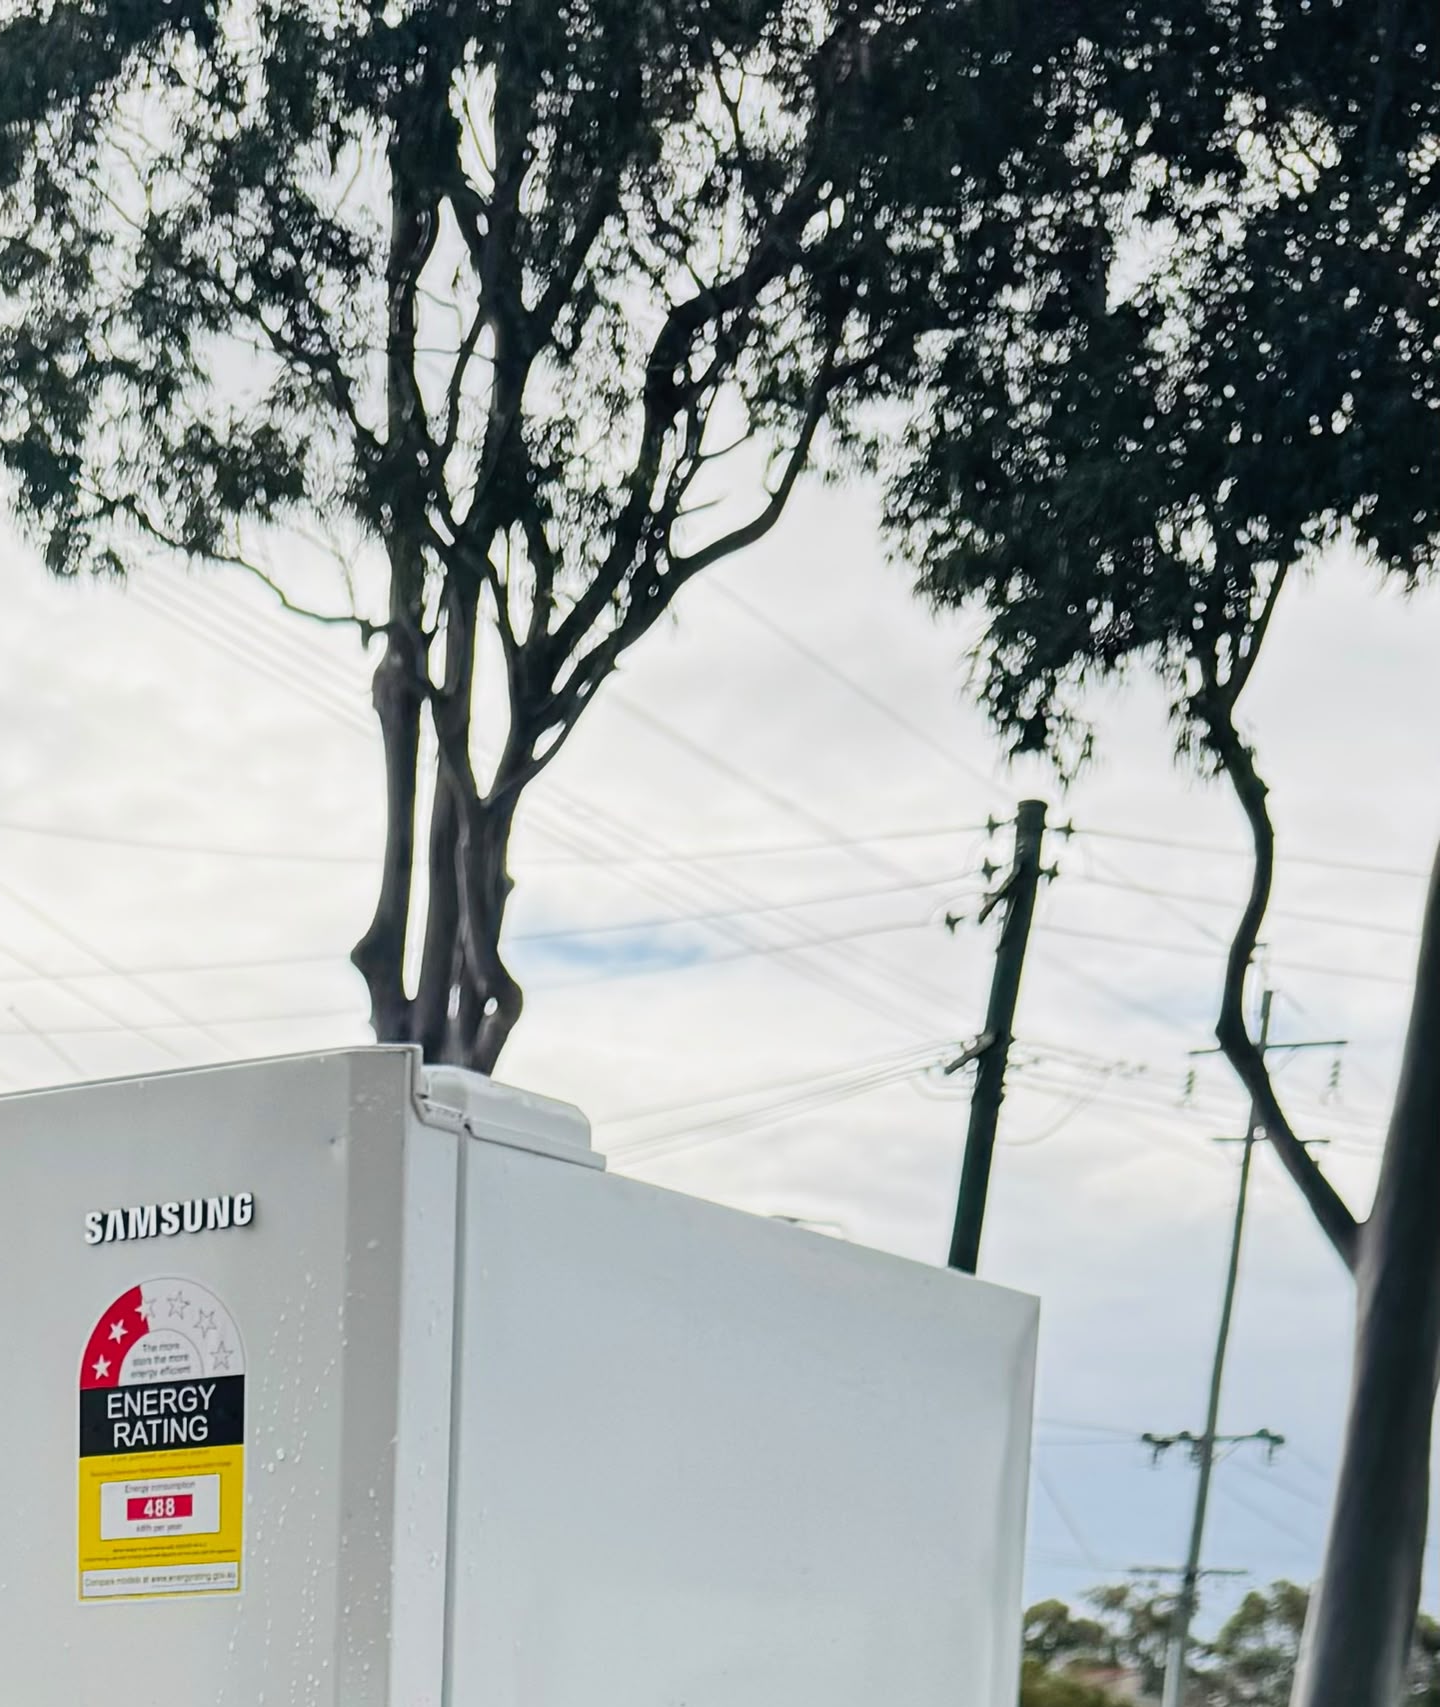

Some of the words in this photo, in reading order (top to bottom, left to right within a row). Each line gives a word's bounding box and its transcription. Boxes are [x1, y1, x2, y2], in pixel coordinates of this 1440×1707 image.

[84, 1192, 254, 1244] SAMSUNG
[107, 1384, 216, 1420] ENERGY
[113, 1416, 209, 1449] RATING
[125, 1484, 149, 1494] Energy
[143, 1498, 175, 1517] 488
